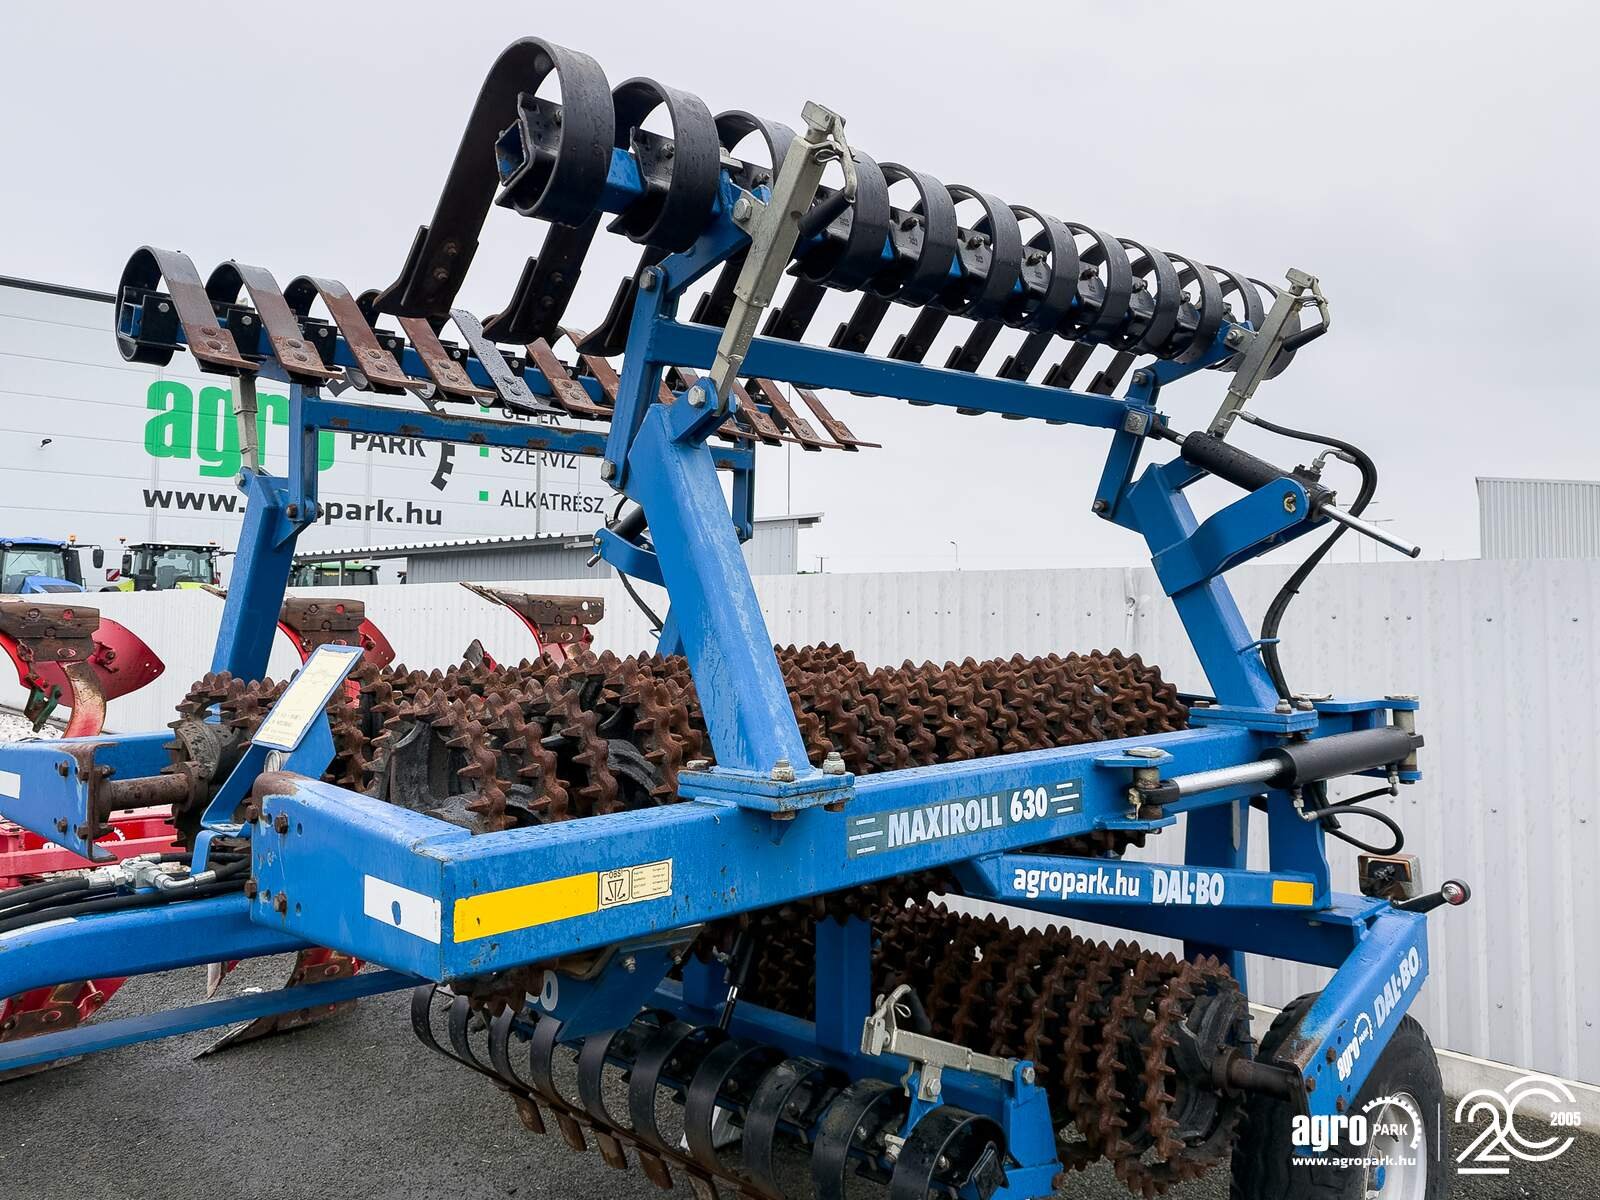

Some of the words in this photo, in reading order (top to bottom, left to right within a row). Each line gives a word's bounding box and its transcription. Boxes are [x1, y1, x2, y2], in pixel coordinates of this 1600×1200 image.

[142, 489, 442, 526] www.park.hu
[500, 489, 604, 515] ALKATRÉSZ
[888, 796, 1003, 848] MAXIROLL
[1009, 786, 1048, 823] 630
[1013, 867, 1140, 900] agropark.hu
